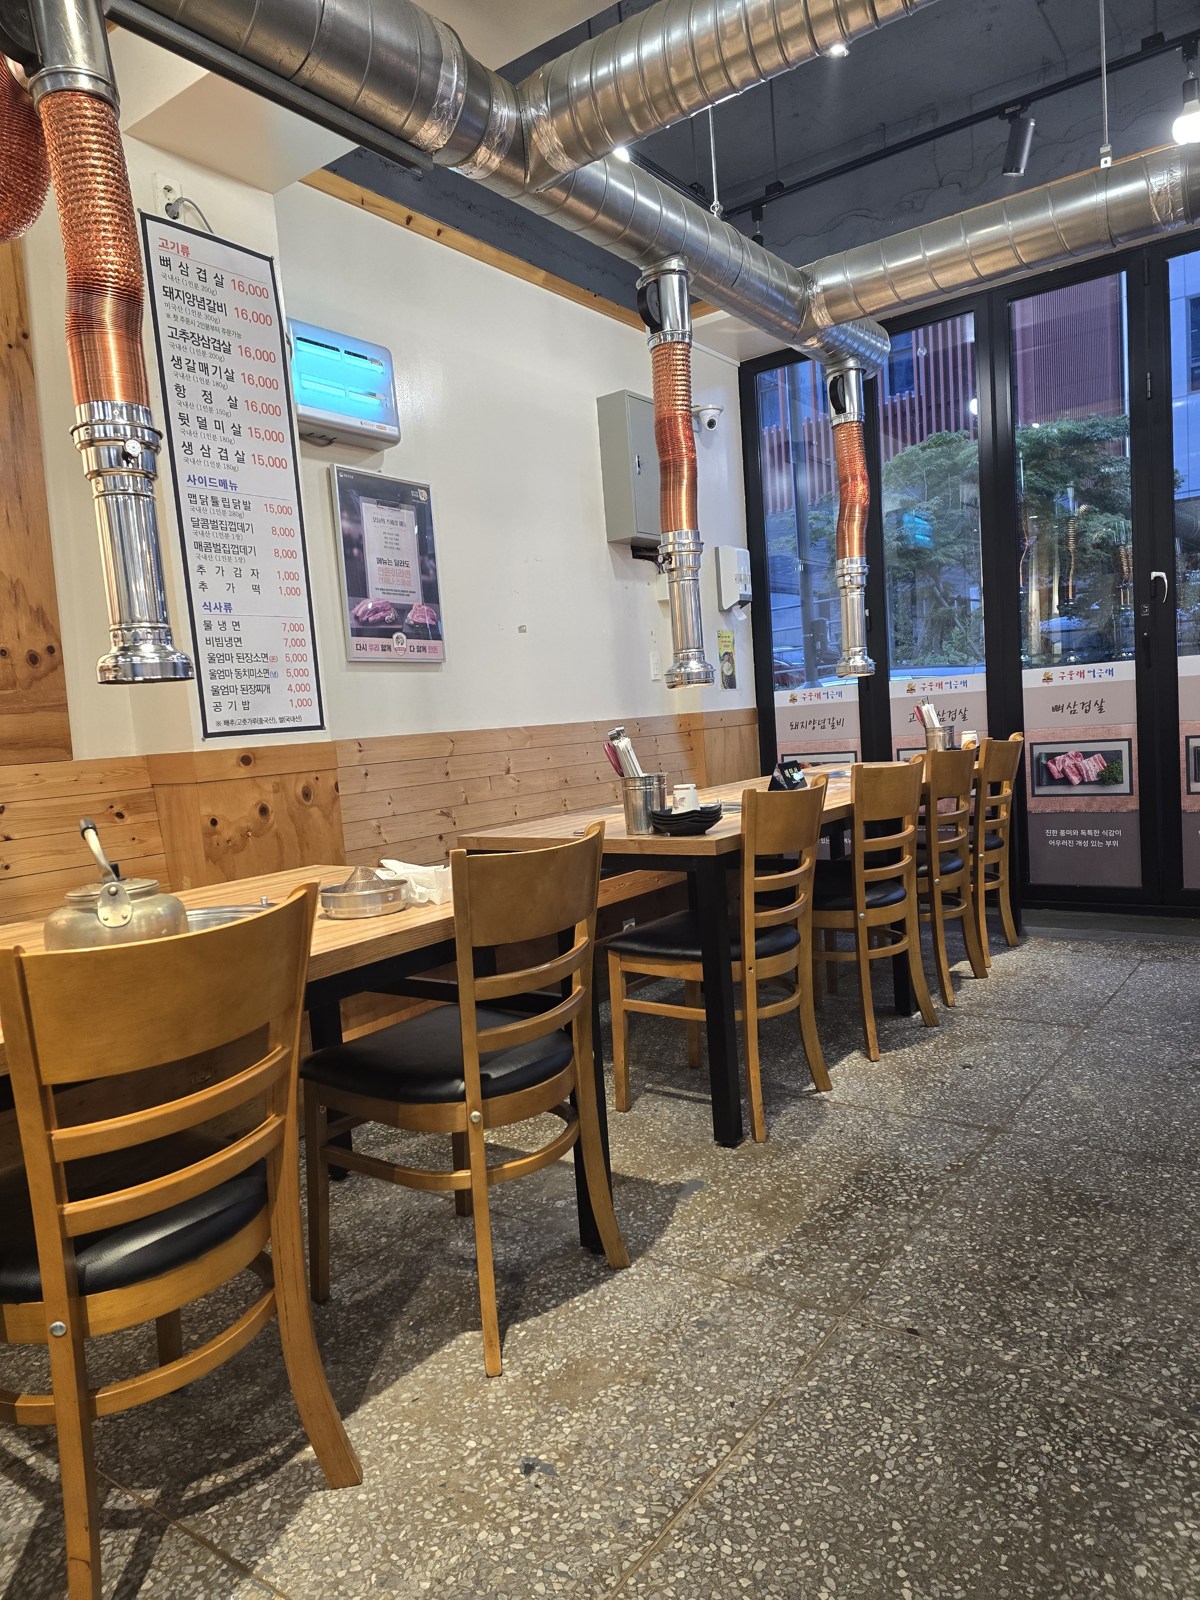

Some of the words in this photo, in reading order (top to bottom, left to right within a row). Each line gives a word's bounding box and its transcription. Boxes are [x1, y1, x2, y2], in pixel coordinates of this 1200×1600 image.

[158, 237, 190, 258] 고기류
[161, 272, 180, 284] 국내산
[231, 279, 269, 299] 16,000
[162, 286, 227, 316] 돼지양념갈비
[234, 307, 272, 326] 16,000
[165, 302, 183, 313] 미국산
[168, 326, 232, 354] 고추장삼겹살
[238, 345, 276, 364] 16,000
[169, 342, 189, 352] 국내산
[170, 355, 234, 382] 생갈매기살
[241, 372, 279, 390] 16,000
[173, 371, 190, 381] 국내산
[176, 400, 194, 410] 국내산
[244, 400, 282, 416] 16,000
[180, 428, 198, 438] 국내산
[248, 427, 284, 443] 15,000
[184, 457, 202, 466] 국내산
[252, 454, 288, 470] 15,000
[187, 474, 238, 491] 사이드메뉴
[190, 506, 208, 514] 국내산
[264, 504, 292, 516] 15,000
[190, 517, 254, 534] 달콤벌집껍데기
[272, 526, 294, 538] 8,000
[193, 530, 210, 538] 국내산
[194, 541, 256, 556] 매콤벌집껍데기
[274, 548, 297, 559] 8,000
[196, 554, 213, 562] 국내산
[277, 571, 299, 580] 1,000
[279, 586, 301, 596] 1,000
[202, 602, 232, 613] 식사류
[282, 623, 304, 632] 7,000
[206, 636, 242, 648] 비빔냉면
[284, 638, 306, 648] 7,000
[356, 644, 368, 652] 다시
[368, 644, 380, 652] 우리
[206, 652, 234, 664] 울엄마
[285, 653, 308, 662] 5,000
[208, 668, 233, 680] 울엄마
[286, 668, 309, 678] 5,000
[210, 684, 238, 696] 울엄마
[240, 684, 270, 694] 된장찌개
[288, 683, 310, 692] 4,000
[290, 698, 312, 708] 1,000
[1052, 698, 1106, 714] 뼈삼겹살
[908, 708, 968, 722] 고삼겹살
[790, 716, 844, 730] 돼지양념갈비
